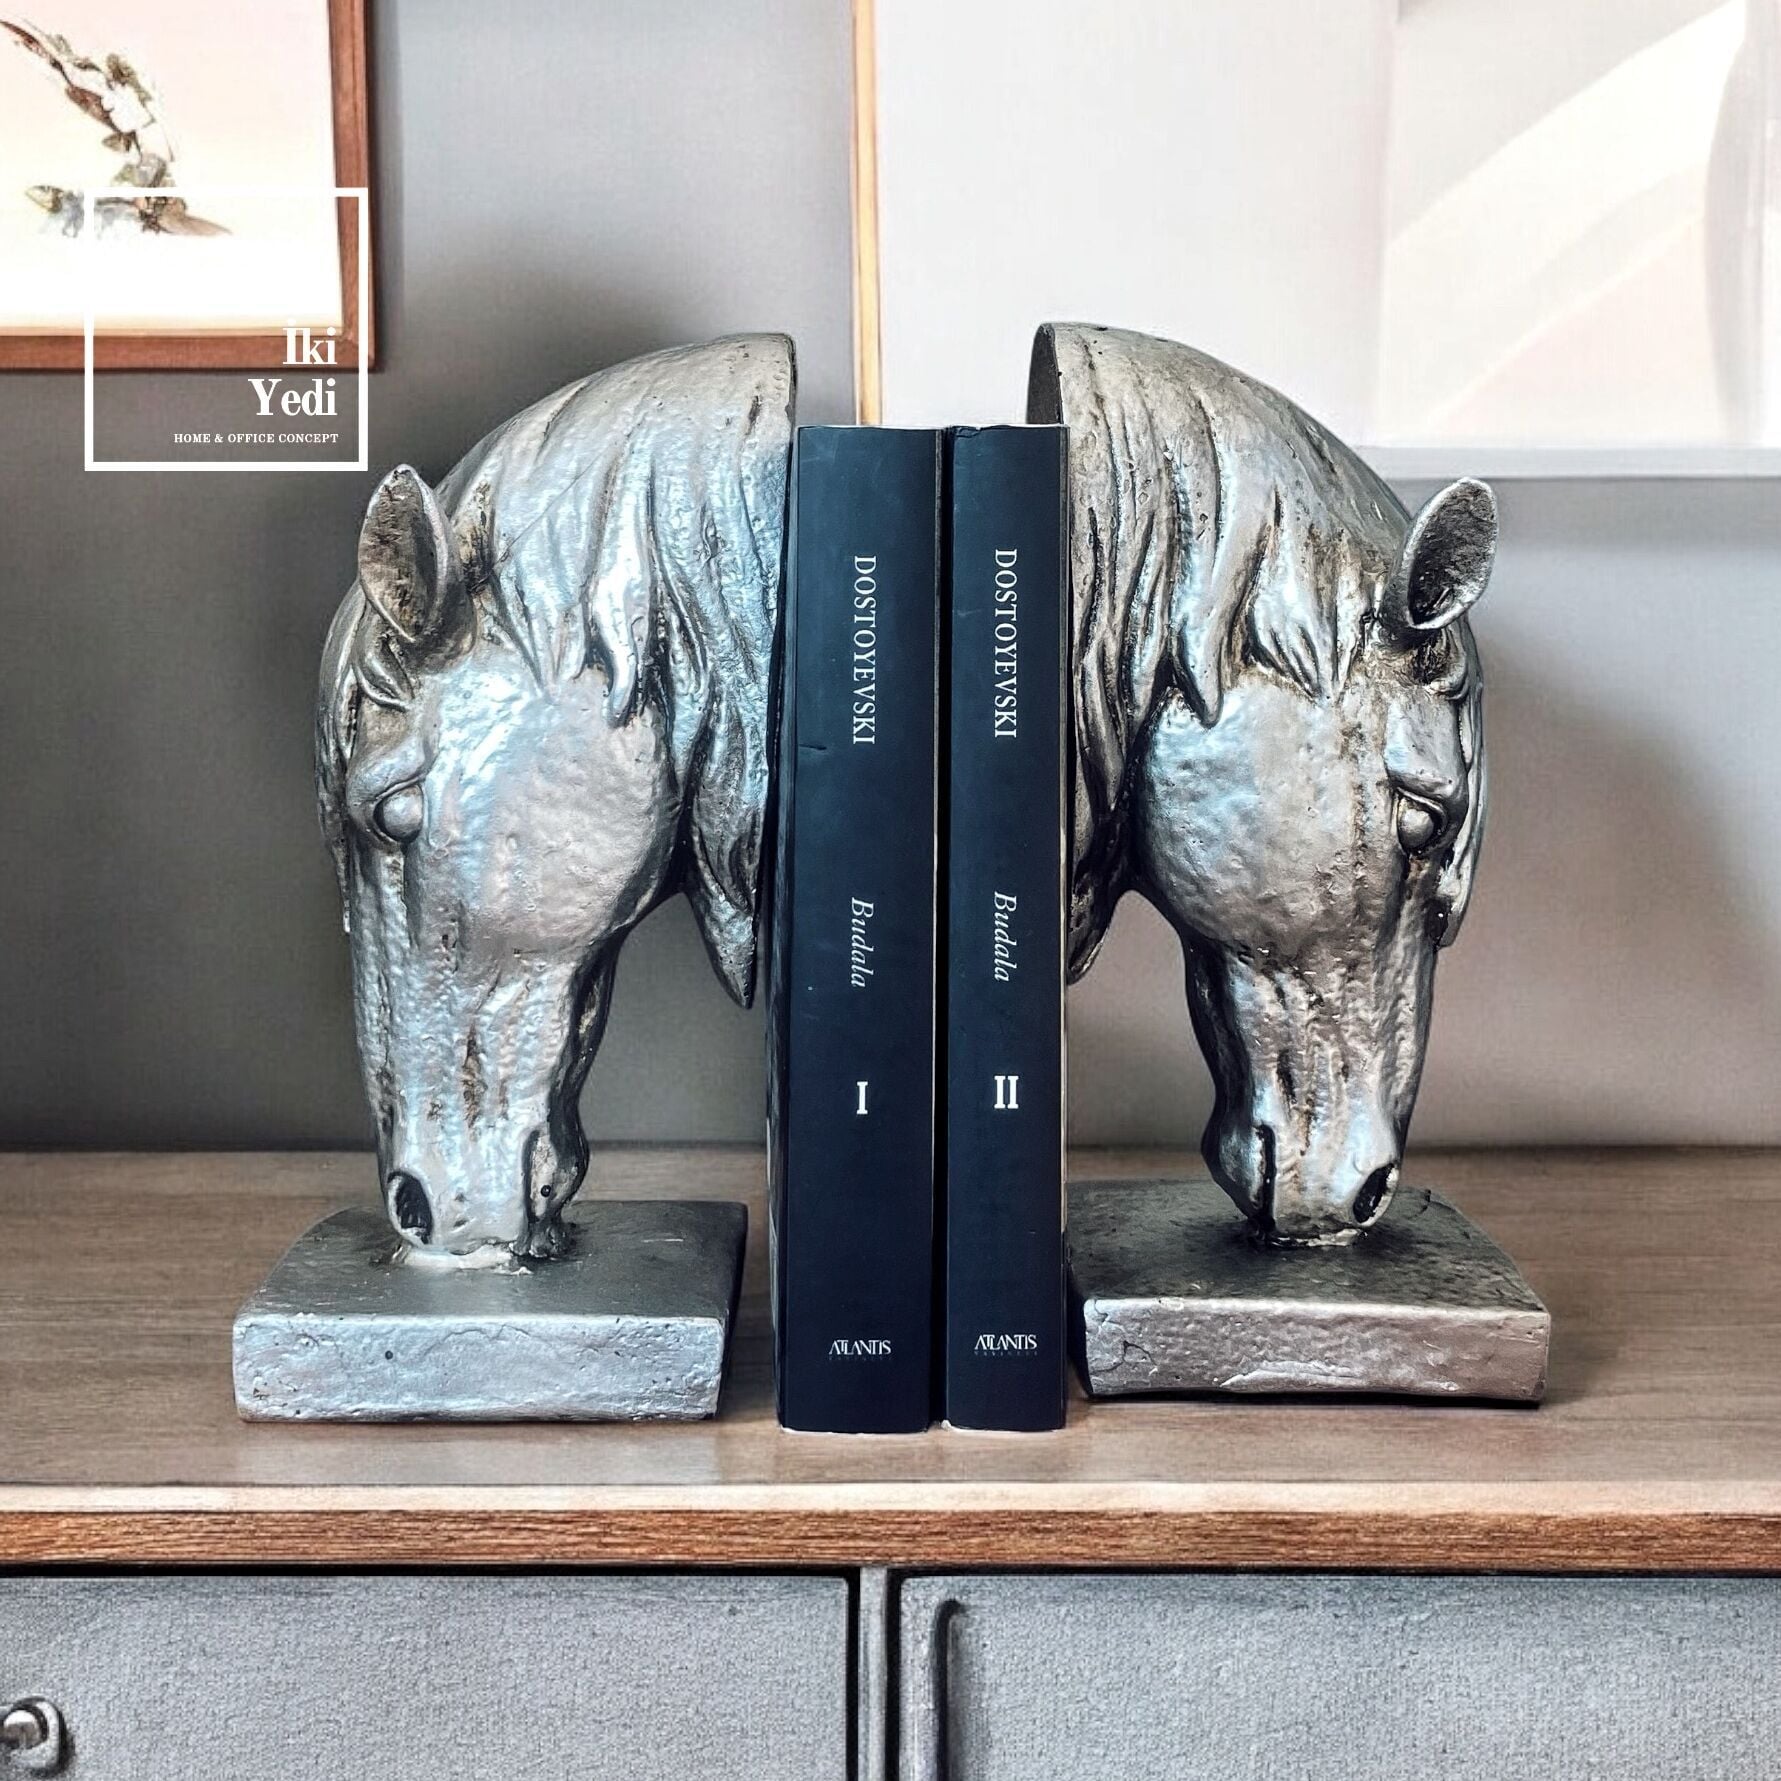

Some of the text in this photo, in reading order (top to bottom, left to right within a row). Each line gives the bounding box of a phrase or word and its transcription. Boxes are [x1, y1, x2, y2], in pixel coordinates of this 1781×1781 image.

[853, 555, 877, 745] DOSTOYEVSKI
[994, 549, 1018, 738] DOSTOYEVSKI
[850, 897, 874, 988] Budala
[994, 891, 1018, 982] Budala
[856, 1081, 869, 1115] I
[994, 1075, 1019, 1109] II
[828, 1339, 892, 1355] ATLANTIS
[974, 1334, 1038, 1350] ATLANTIS
